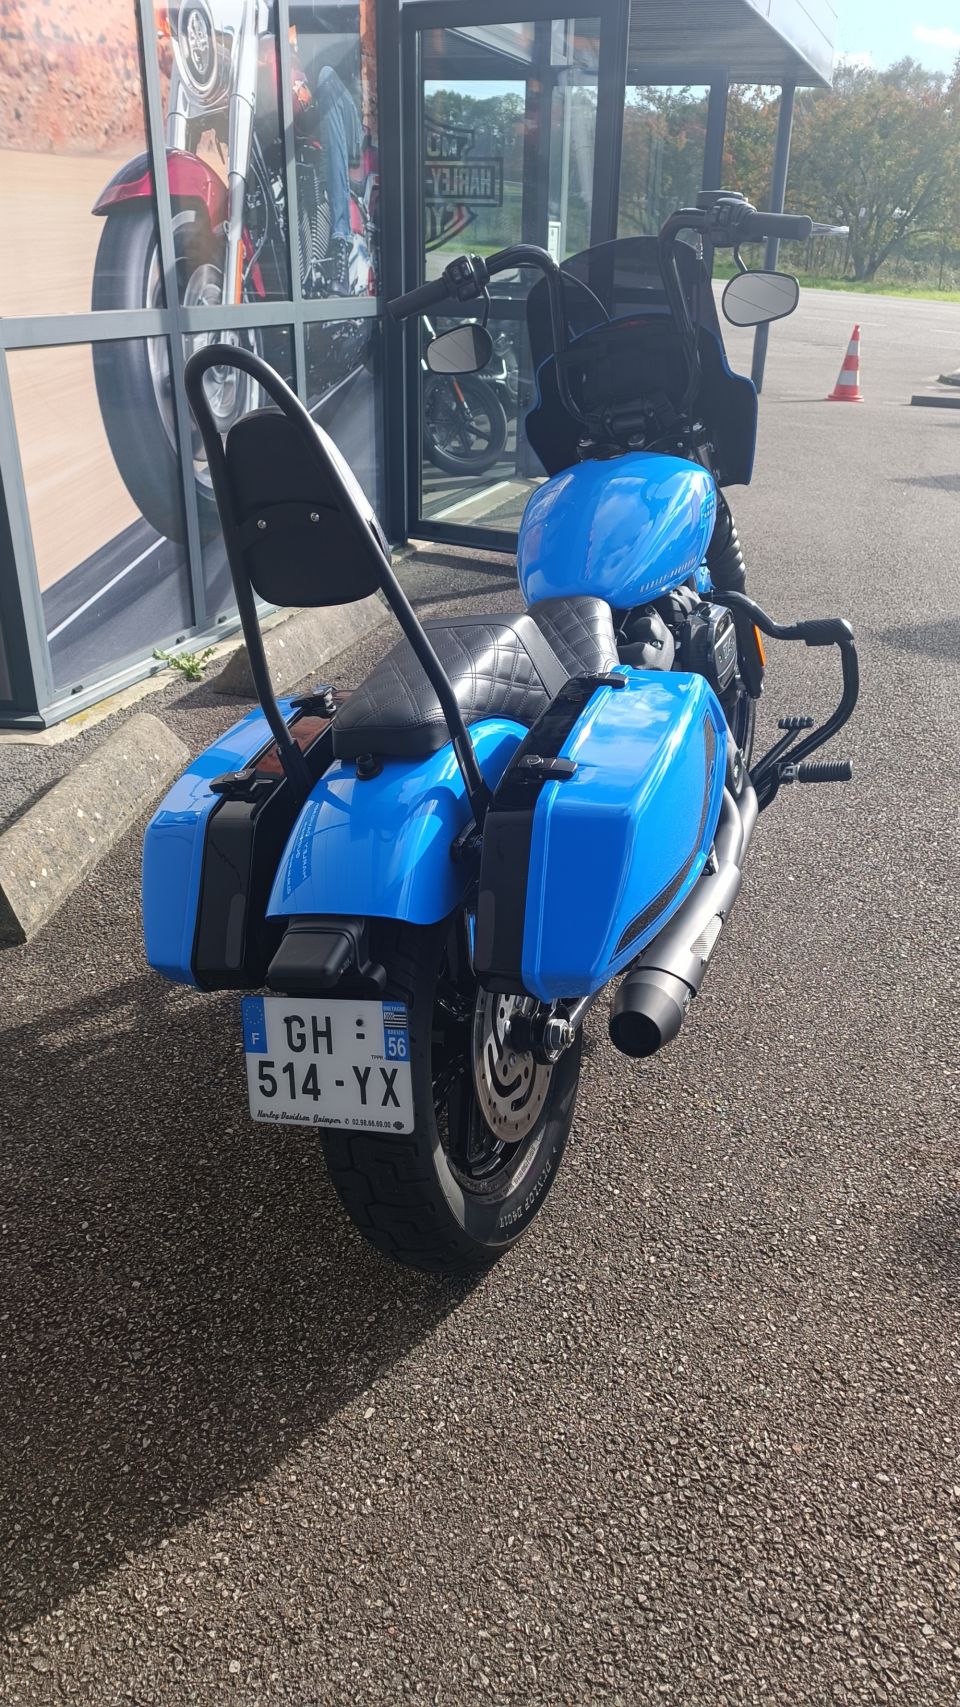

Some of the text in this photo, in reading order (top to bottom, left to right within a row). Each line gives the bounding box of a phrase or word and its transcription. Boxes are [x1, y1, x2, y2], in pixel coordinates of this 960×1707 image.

[251, 1032, 260, 1045] F
[388, 1037, 407, 1058] 56
[281, 1112, 310, 1122] Davidson
